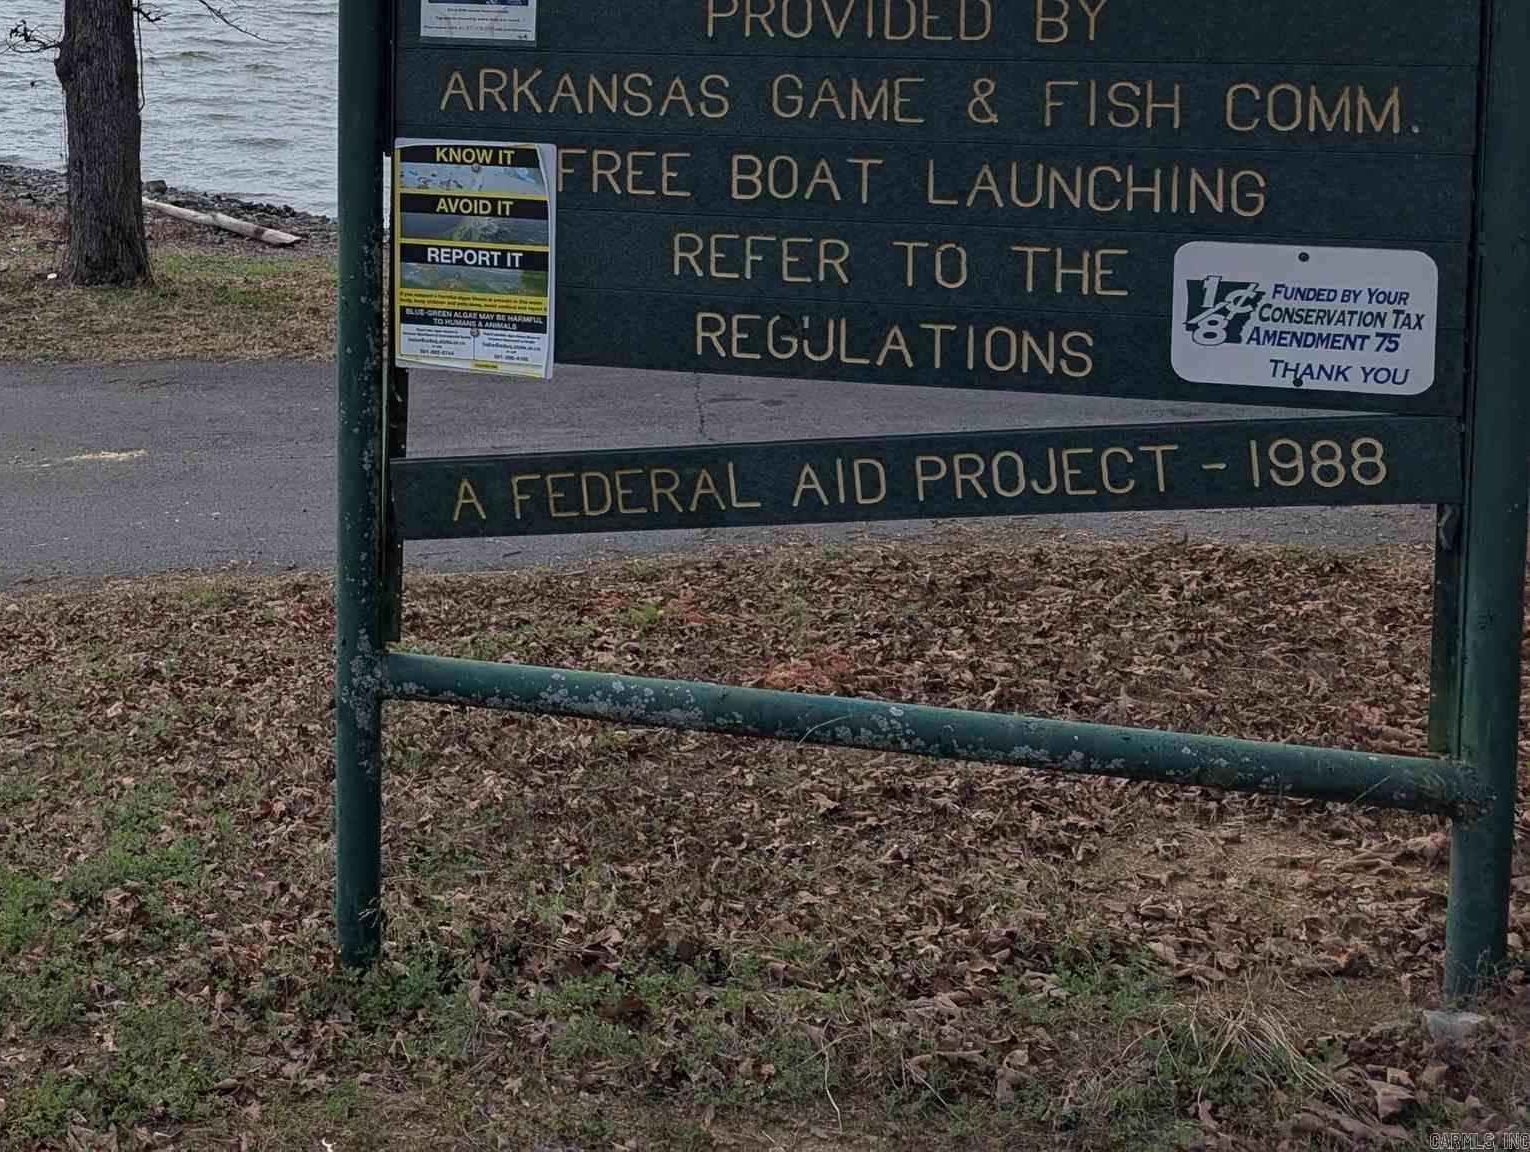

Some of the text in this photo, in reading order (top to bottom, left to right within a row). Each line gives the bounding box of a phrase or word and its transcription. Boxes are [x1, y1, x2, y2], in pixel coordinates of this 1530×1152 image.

[440, 67, 1420, 134] ARKANSAS GAME & FISH COMM.
[436, 147, 515, 165] KNOW IT
[557, 149, 1267, 216] FREE BOAT LAUNCHING
[436, 197, 514, 216] AVOID IT
[427, 247, 523, 268] REPORT IT
[673, 232, 1129, 296] REFER TO THE
[695, 311, 1094, 376] REGULATIONS
[1374, 332, 1402, 353] 75
[454, 479, 486, 522] A
[511, 462, 762, 519] FEDERAL
[793, 457, 886, 507] AID
[917, 444, 1179, 500] PROJECT
[1250, 438, 1387, 488] 1988
